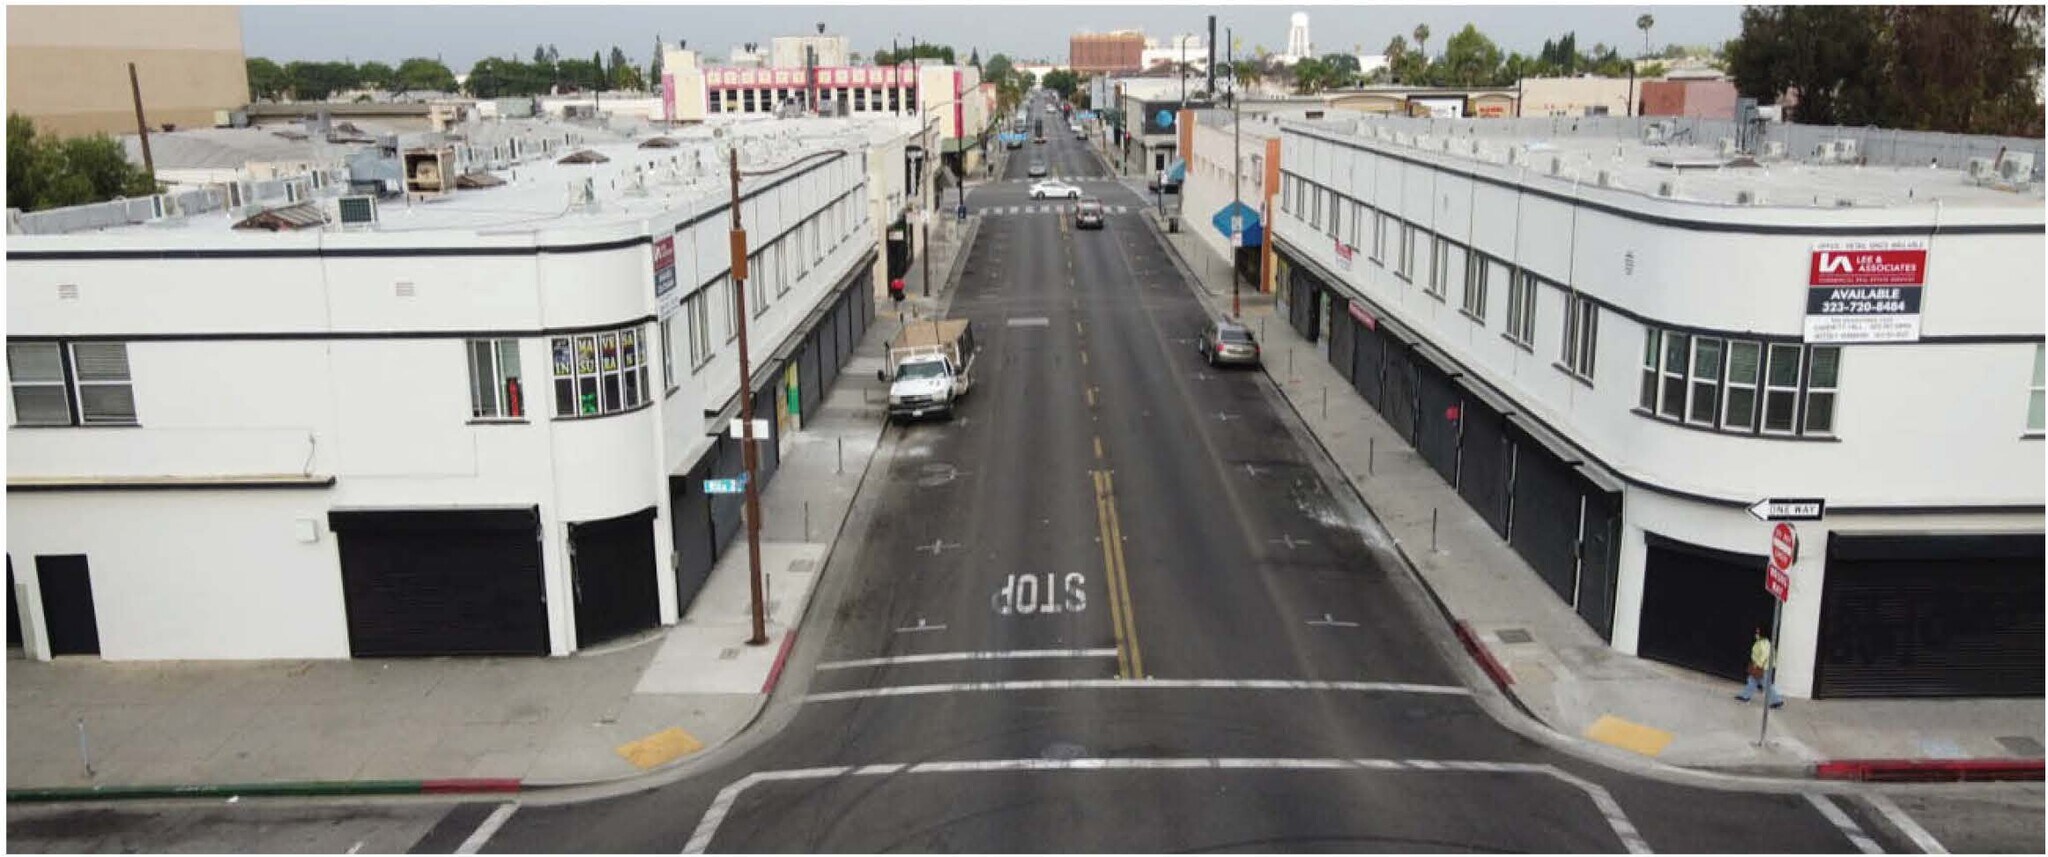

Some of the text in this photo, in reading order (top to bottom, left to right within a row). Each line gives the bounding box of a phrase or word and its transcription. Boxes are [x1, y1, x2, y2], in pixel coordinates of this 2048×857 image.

[1856, 255, 1883, 264] LEE &
[1858, 263, 1917, 272] ASSOCIATES
[1830, 288, 1901, 300] AVAILABLE
[1821, 300, 1905, 312] 323-720-8484
[1769, 505, 1816, 514] ONE WAY
[991, 571, 1087, 614] STOP
